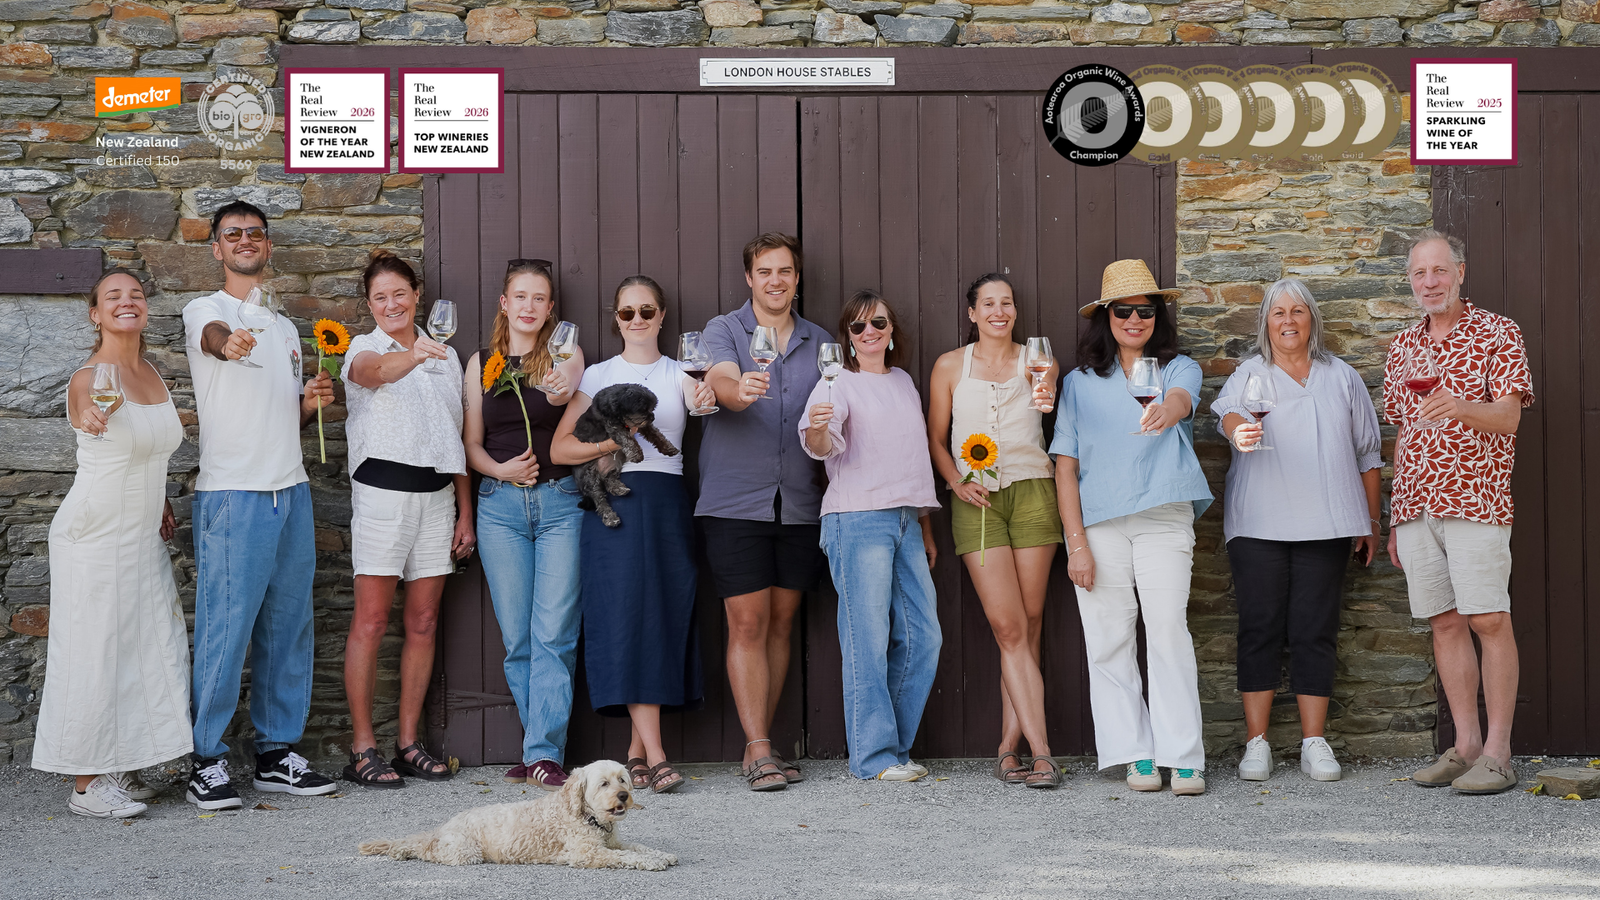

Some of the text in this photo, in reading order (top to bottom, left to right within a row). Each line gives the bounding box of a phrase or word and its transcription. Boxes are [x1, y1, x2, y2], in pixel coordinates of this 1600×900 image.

[724, 67, 872, 78] LONDON HOUSE STABLES
